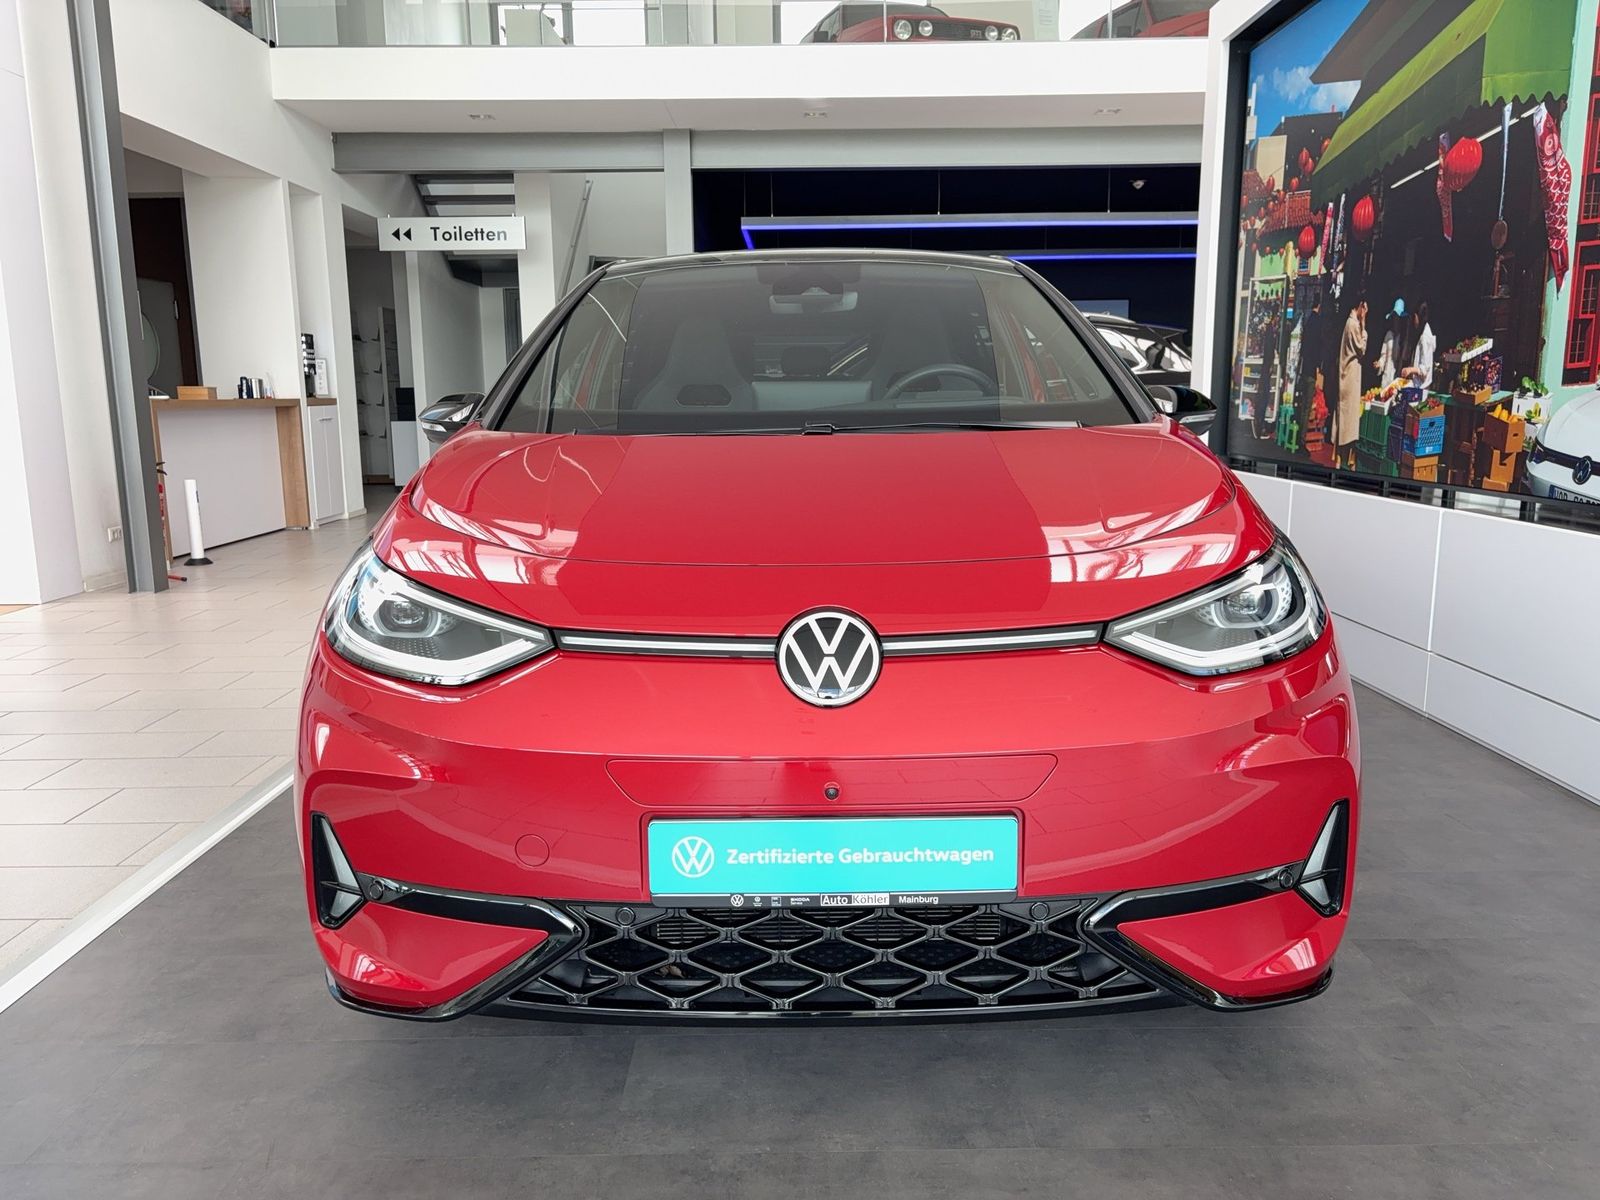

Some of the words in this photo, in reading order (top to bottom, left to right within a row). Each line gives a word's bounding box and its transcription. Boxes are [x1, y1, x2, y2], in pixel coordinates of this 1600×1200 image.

[430, 225, 508, 242] Toiletten
[726, 847, 835, 865] Zertifizierte
[838, 846, 994, 865] Gebrauchtwagen
[822, 895, 849, 905] Auto
[852, 894, 889, 904] Köhler
[899, 895, 939, 905] Mainburg
